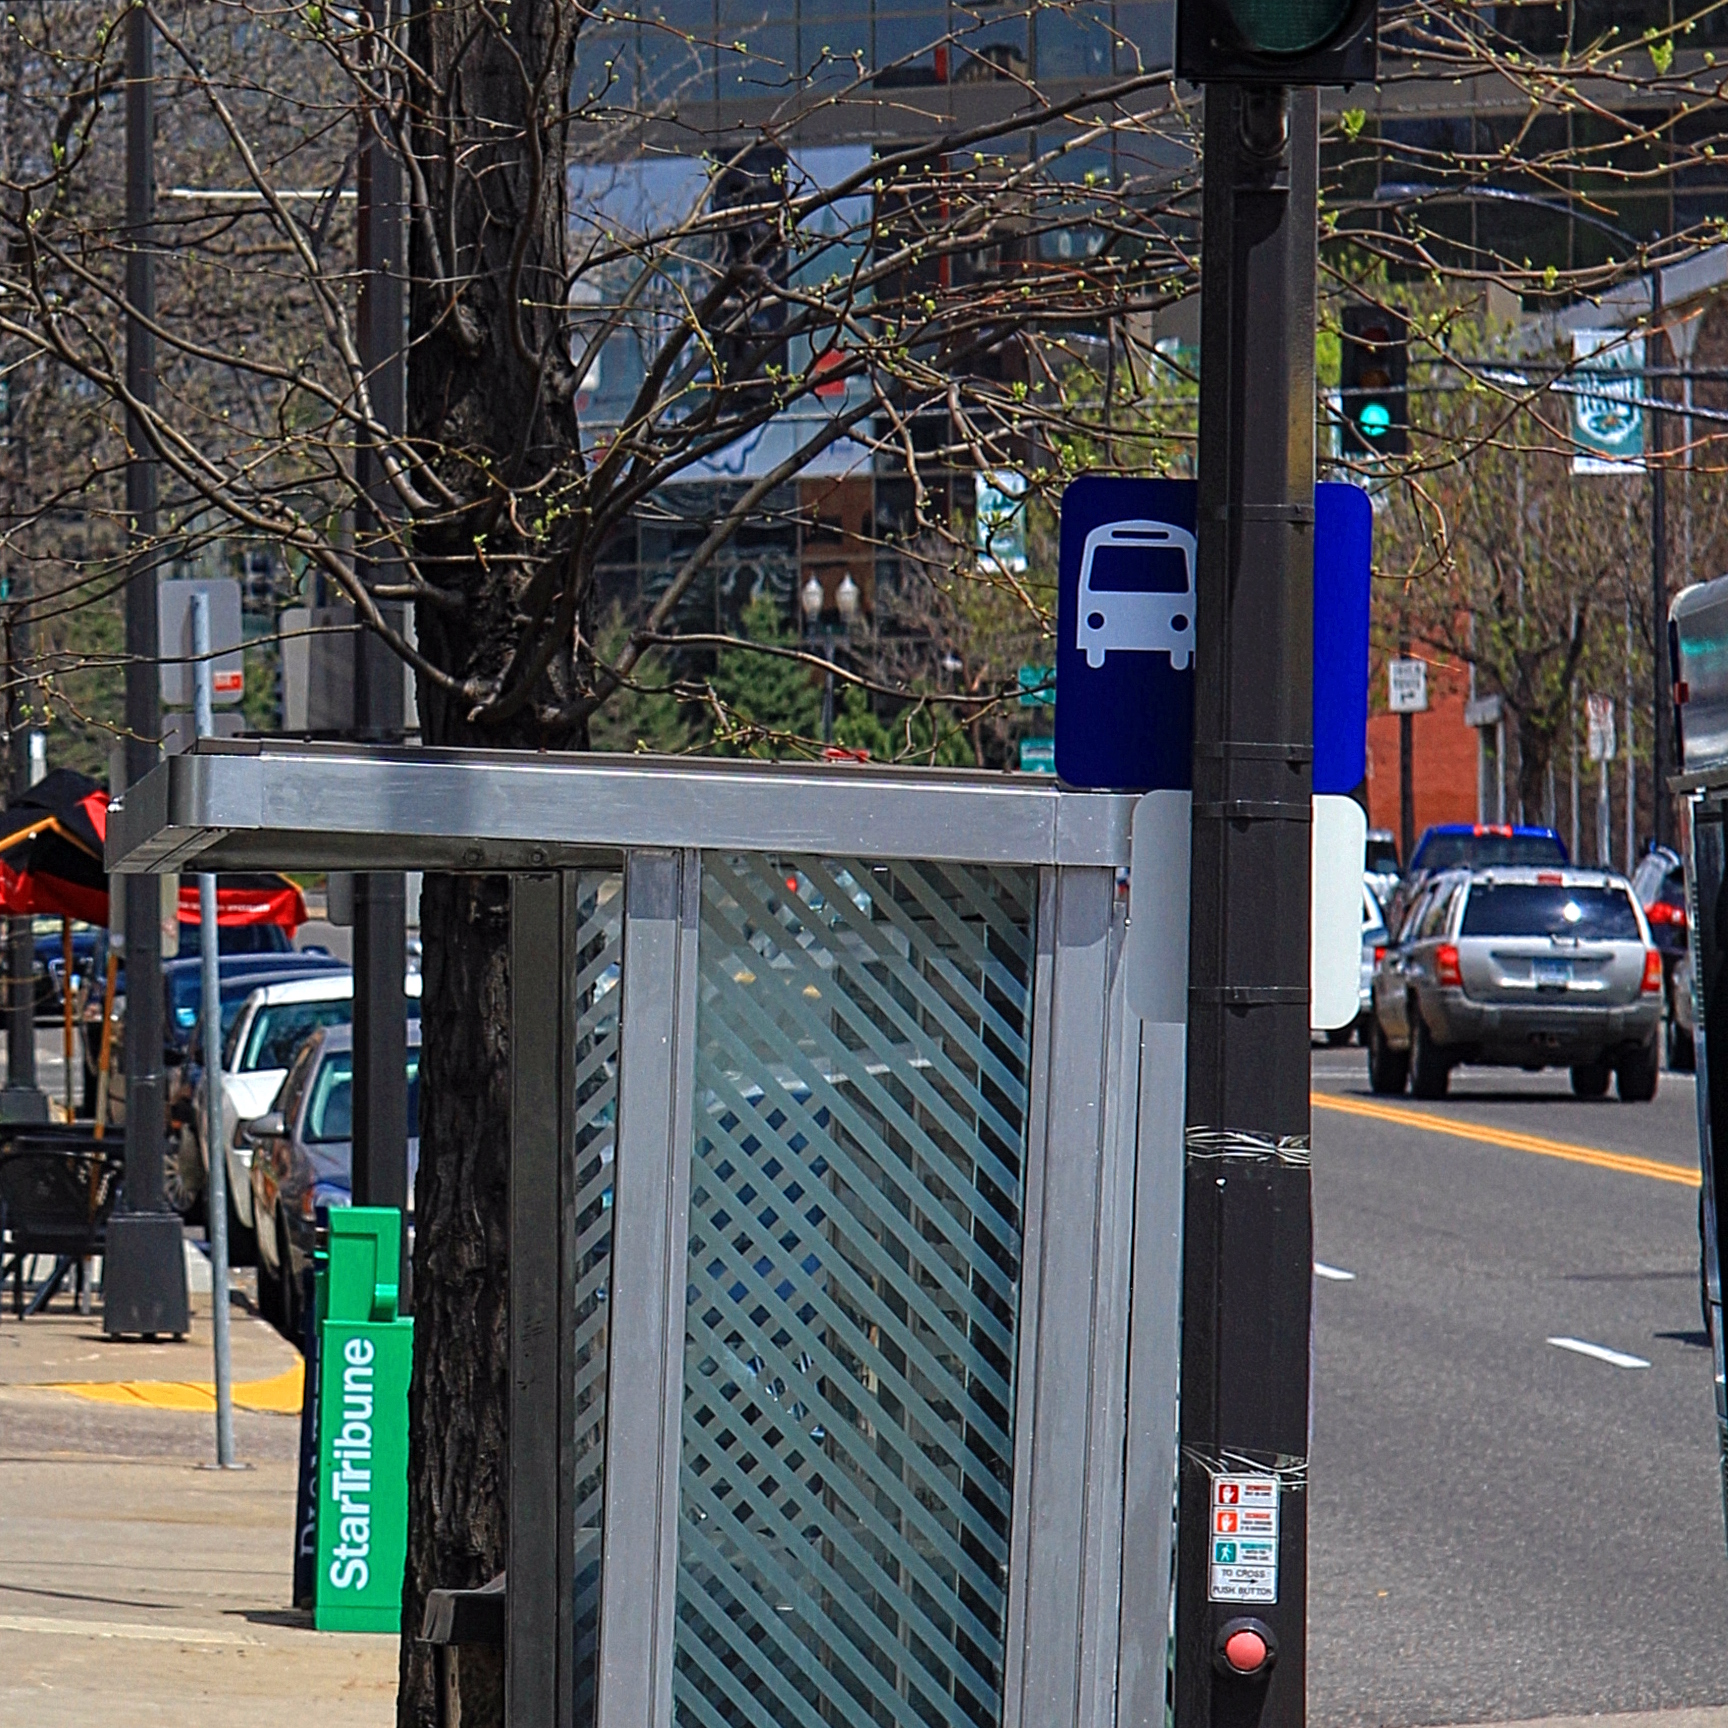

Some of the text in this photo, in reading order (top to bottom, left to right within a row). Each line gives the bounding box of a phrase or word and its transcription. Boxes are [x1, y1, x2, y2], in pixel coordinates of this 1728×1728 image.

[329, 1338, 375, 1590] StarTribune
[1236, 1569, 1266, 1578] CROSS
[1213, 1586, 1273, 1595] PUSH BUTTON
